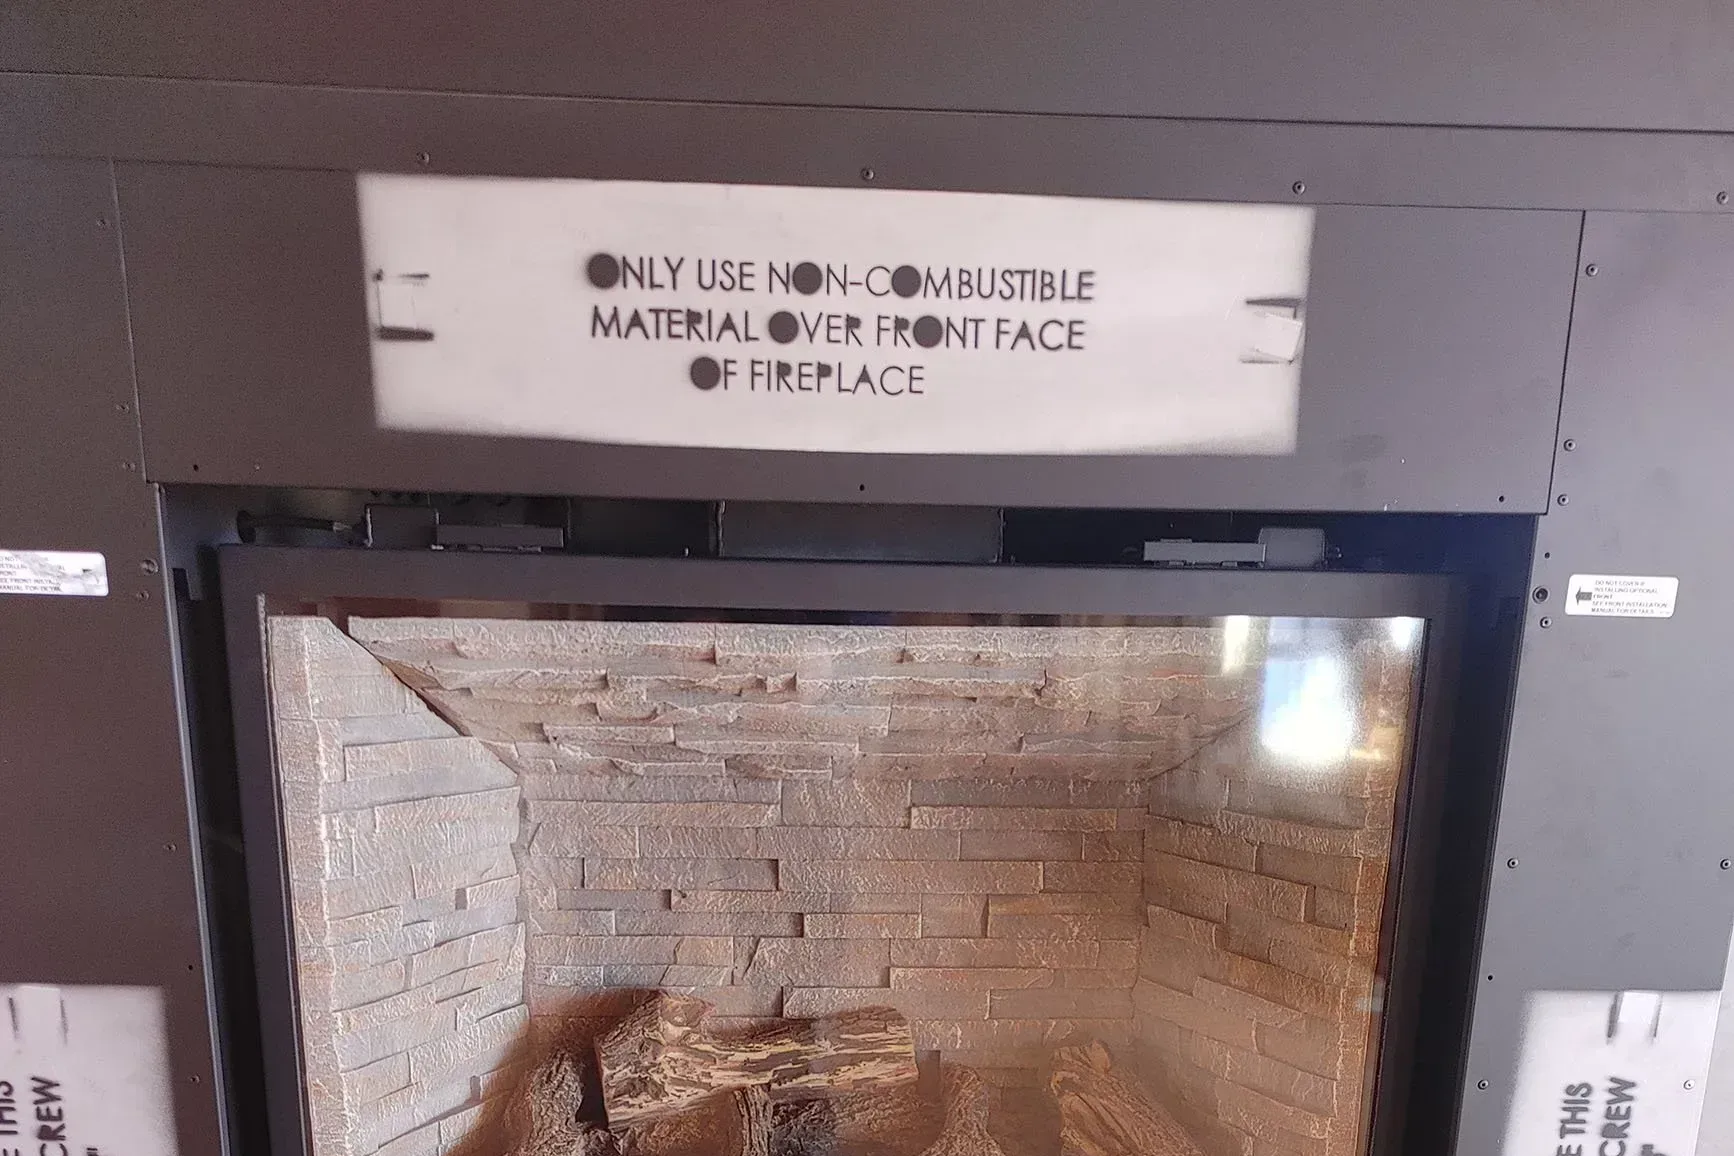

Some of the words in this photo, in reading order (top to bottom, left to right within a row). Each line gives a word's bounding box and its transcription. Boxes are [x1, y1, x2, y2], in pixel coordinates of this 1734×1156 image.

[583, 251, 685, 292] ONLY
[697, 258, 755, 294] USE
[768, 261, 1095, 303] NON-COMBUSTIBLE
[591, 304, 760, 343] MATERIAL
[766, 310, 863, 347] OVER
[876, 314, 986, 350] FRONT
[995, 317, 1085, 352] FACE
[688, 355, 738, 392] OF
[750, 358, 925, 396] FIREPLACE
[1559, 1082, 1593, 1140] THIS
